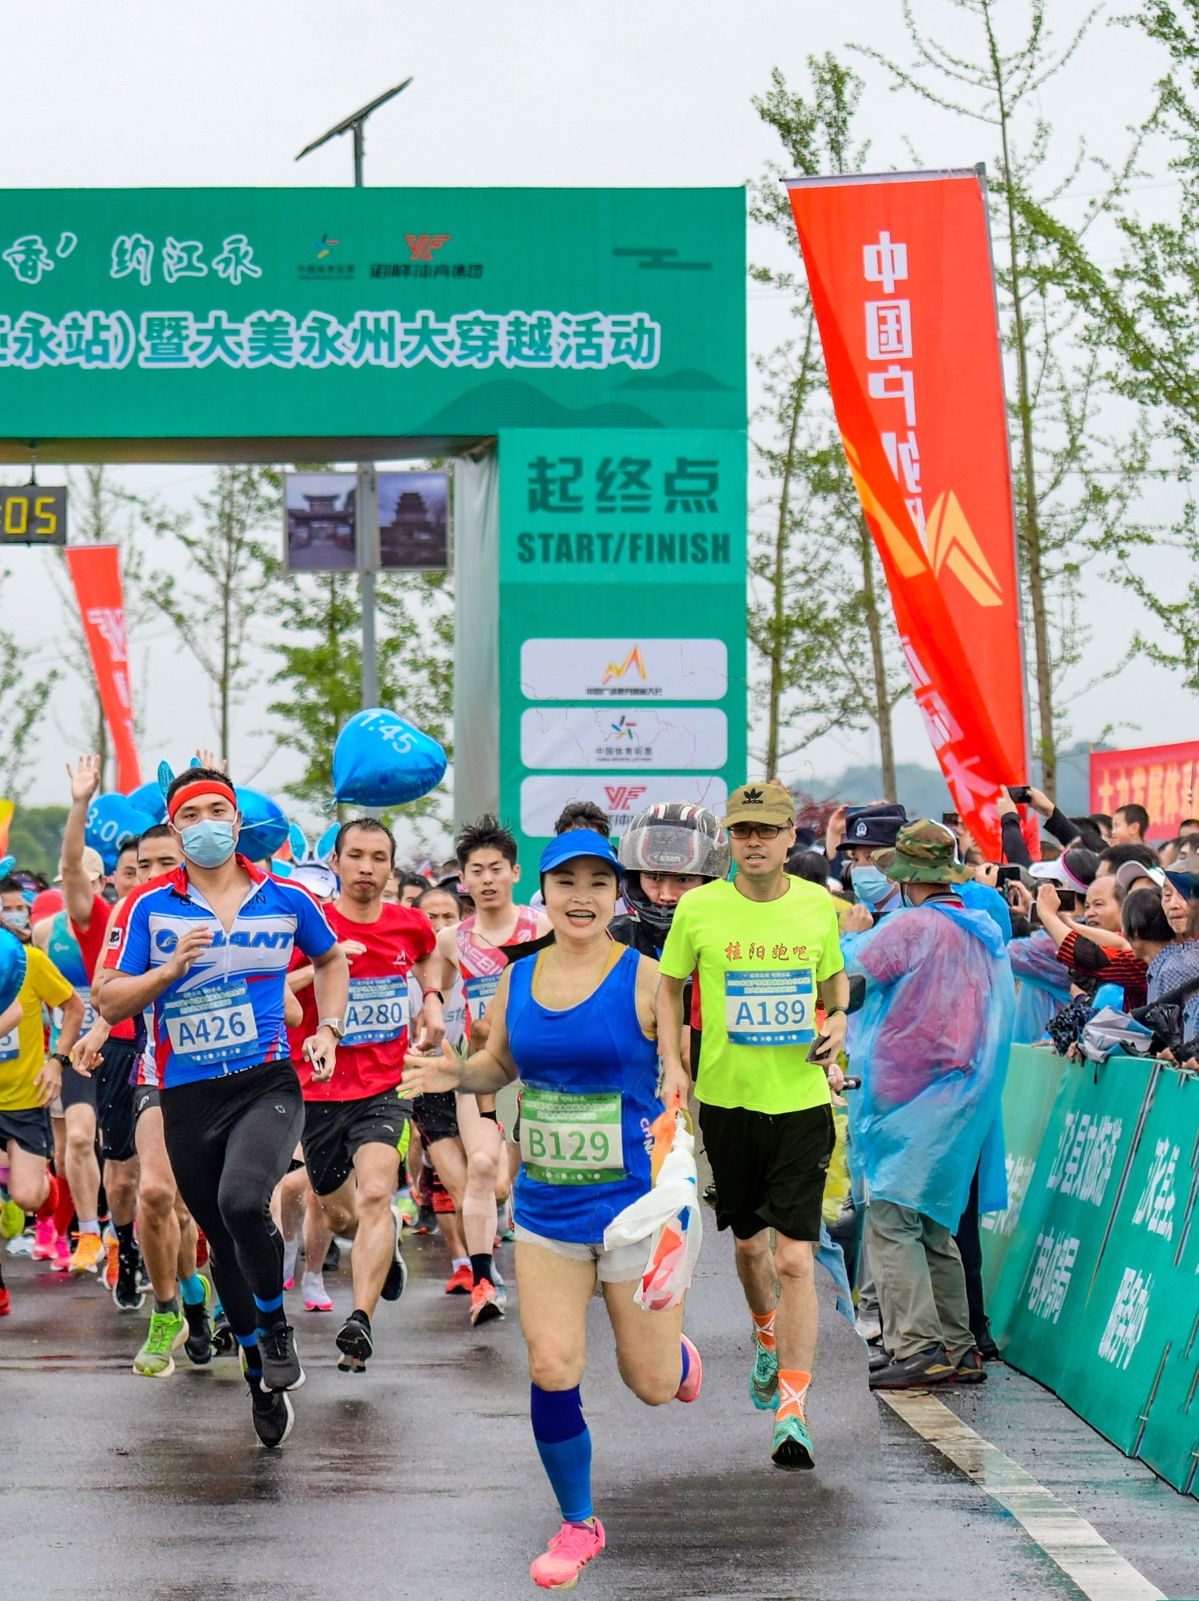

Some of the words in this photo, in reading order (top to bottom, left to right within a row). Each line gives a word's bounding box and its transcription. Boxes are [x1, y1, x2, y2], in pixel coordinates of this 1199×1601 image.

[526, 456, 721, 515] 起终点
[516, 531, 732, 565] START/FINISH
[359, 713, 419, 754] 1:45
[724, 941, 810, 962] 桂阳跑吧
[178, 1011, 247, 1047] A426
[345, 1002, 403, 1028] A280
[734, 999, 806, 1027] A189
[528, 1127, 611, 1162] B129
